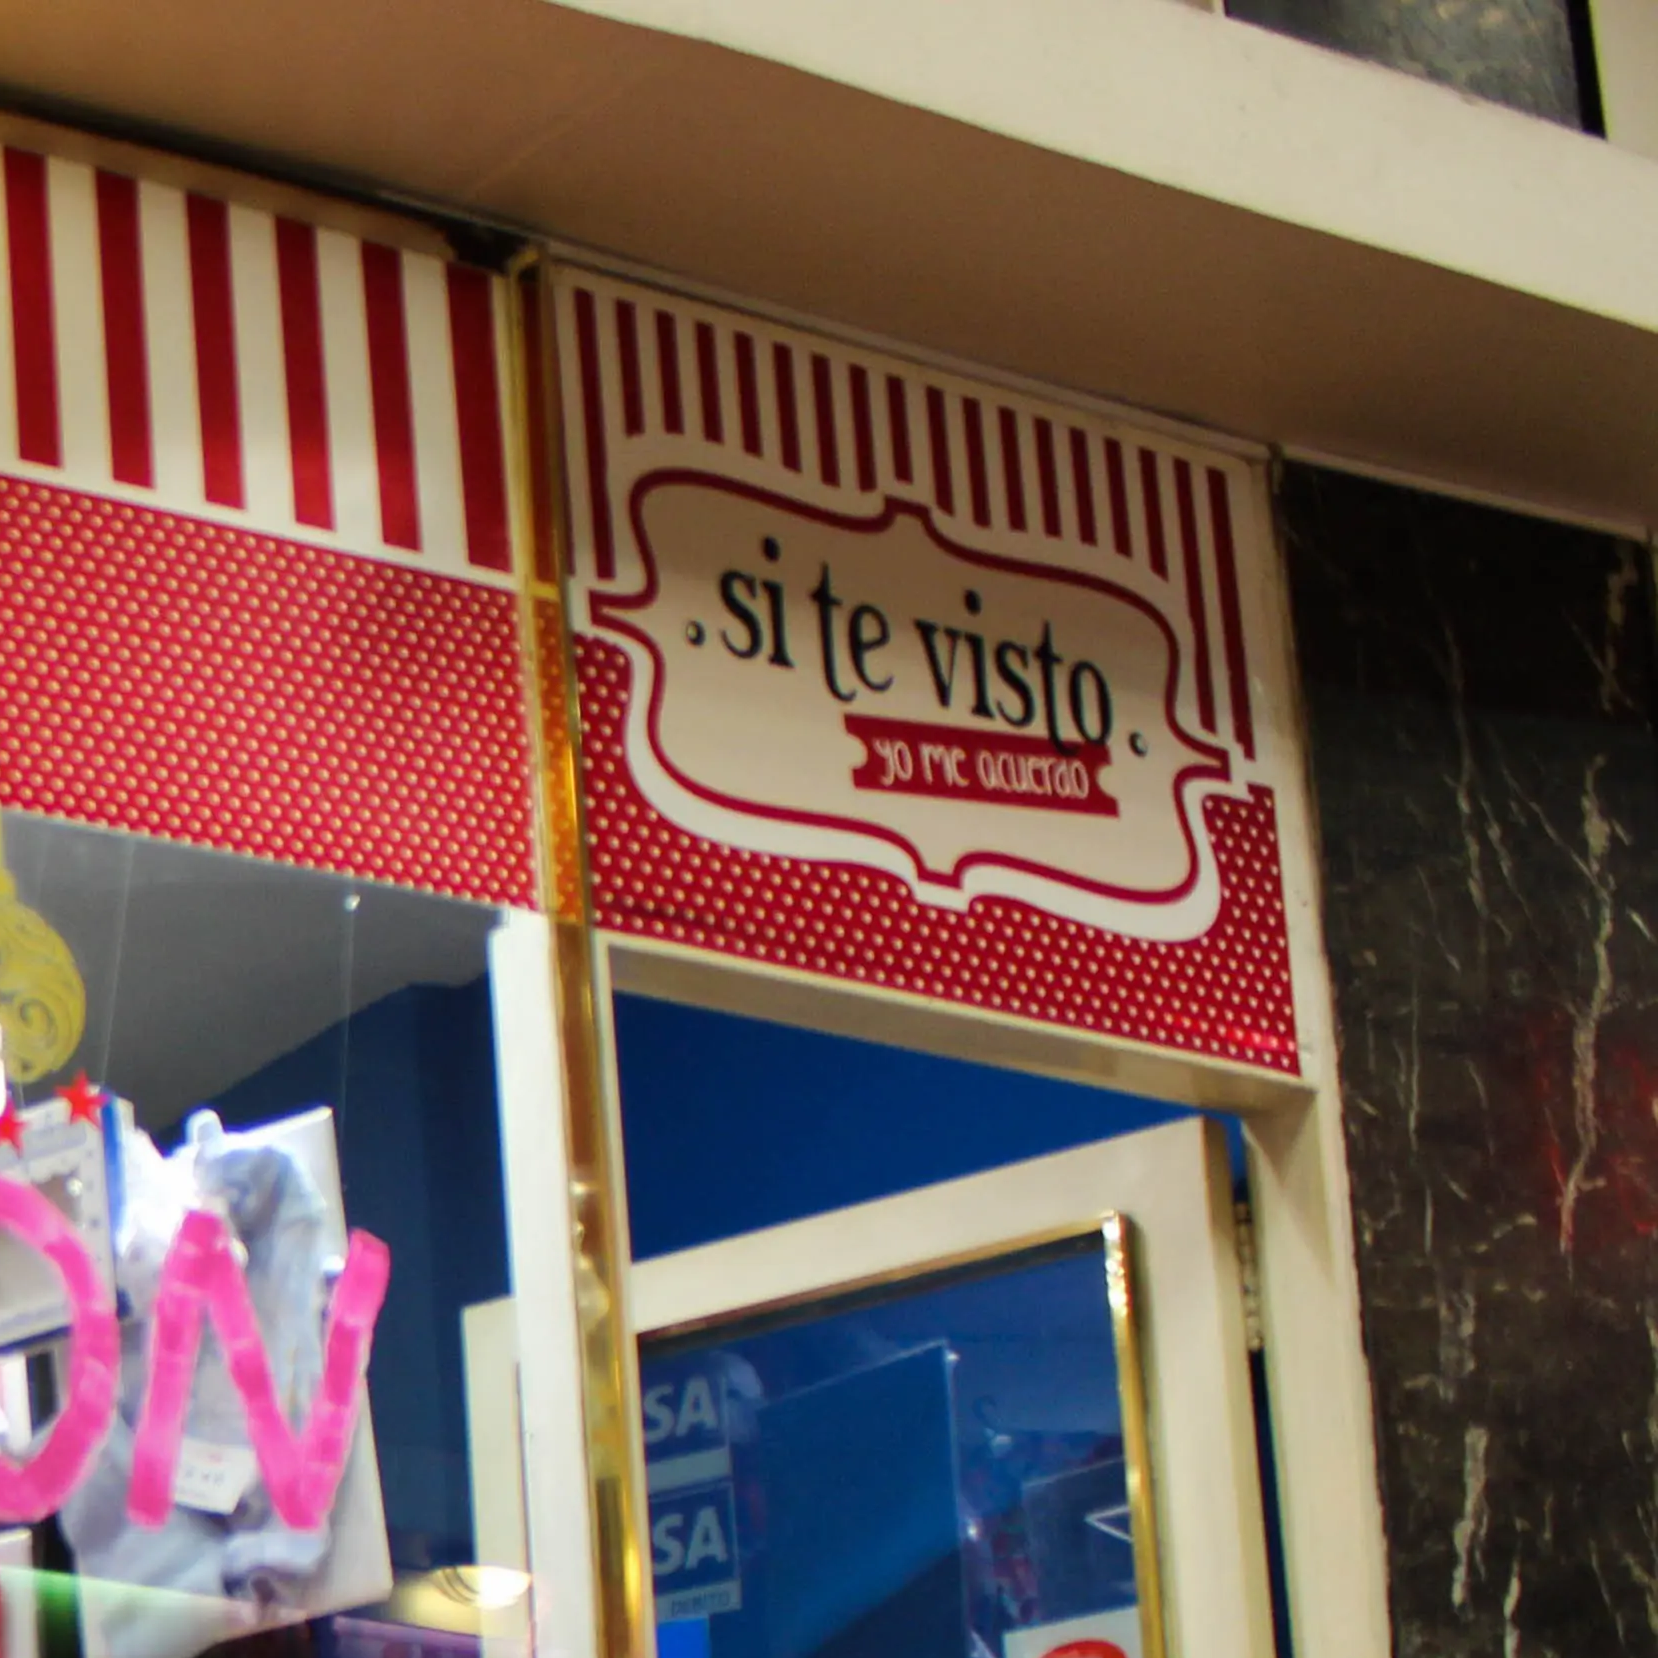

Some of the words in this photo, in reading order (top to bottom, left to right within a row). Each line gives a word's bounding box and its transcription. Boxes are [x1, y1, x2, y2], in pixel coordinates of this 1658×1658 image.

[717, 535, 796, 671] si
[810, 558, 895, 705] te
[912, 586, 1116, 758] visto
[871, 736, 914, 787] yo
[919, 738, 969, 791] me
[978, 744, 1092, 801] acuerdo
[644, 1375, 719, 1446] SA
[653, 1505, 729, 1577] SA
